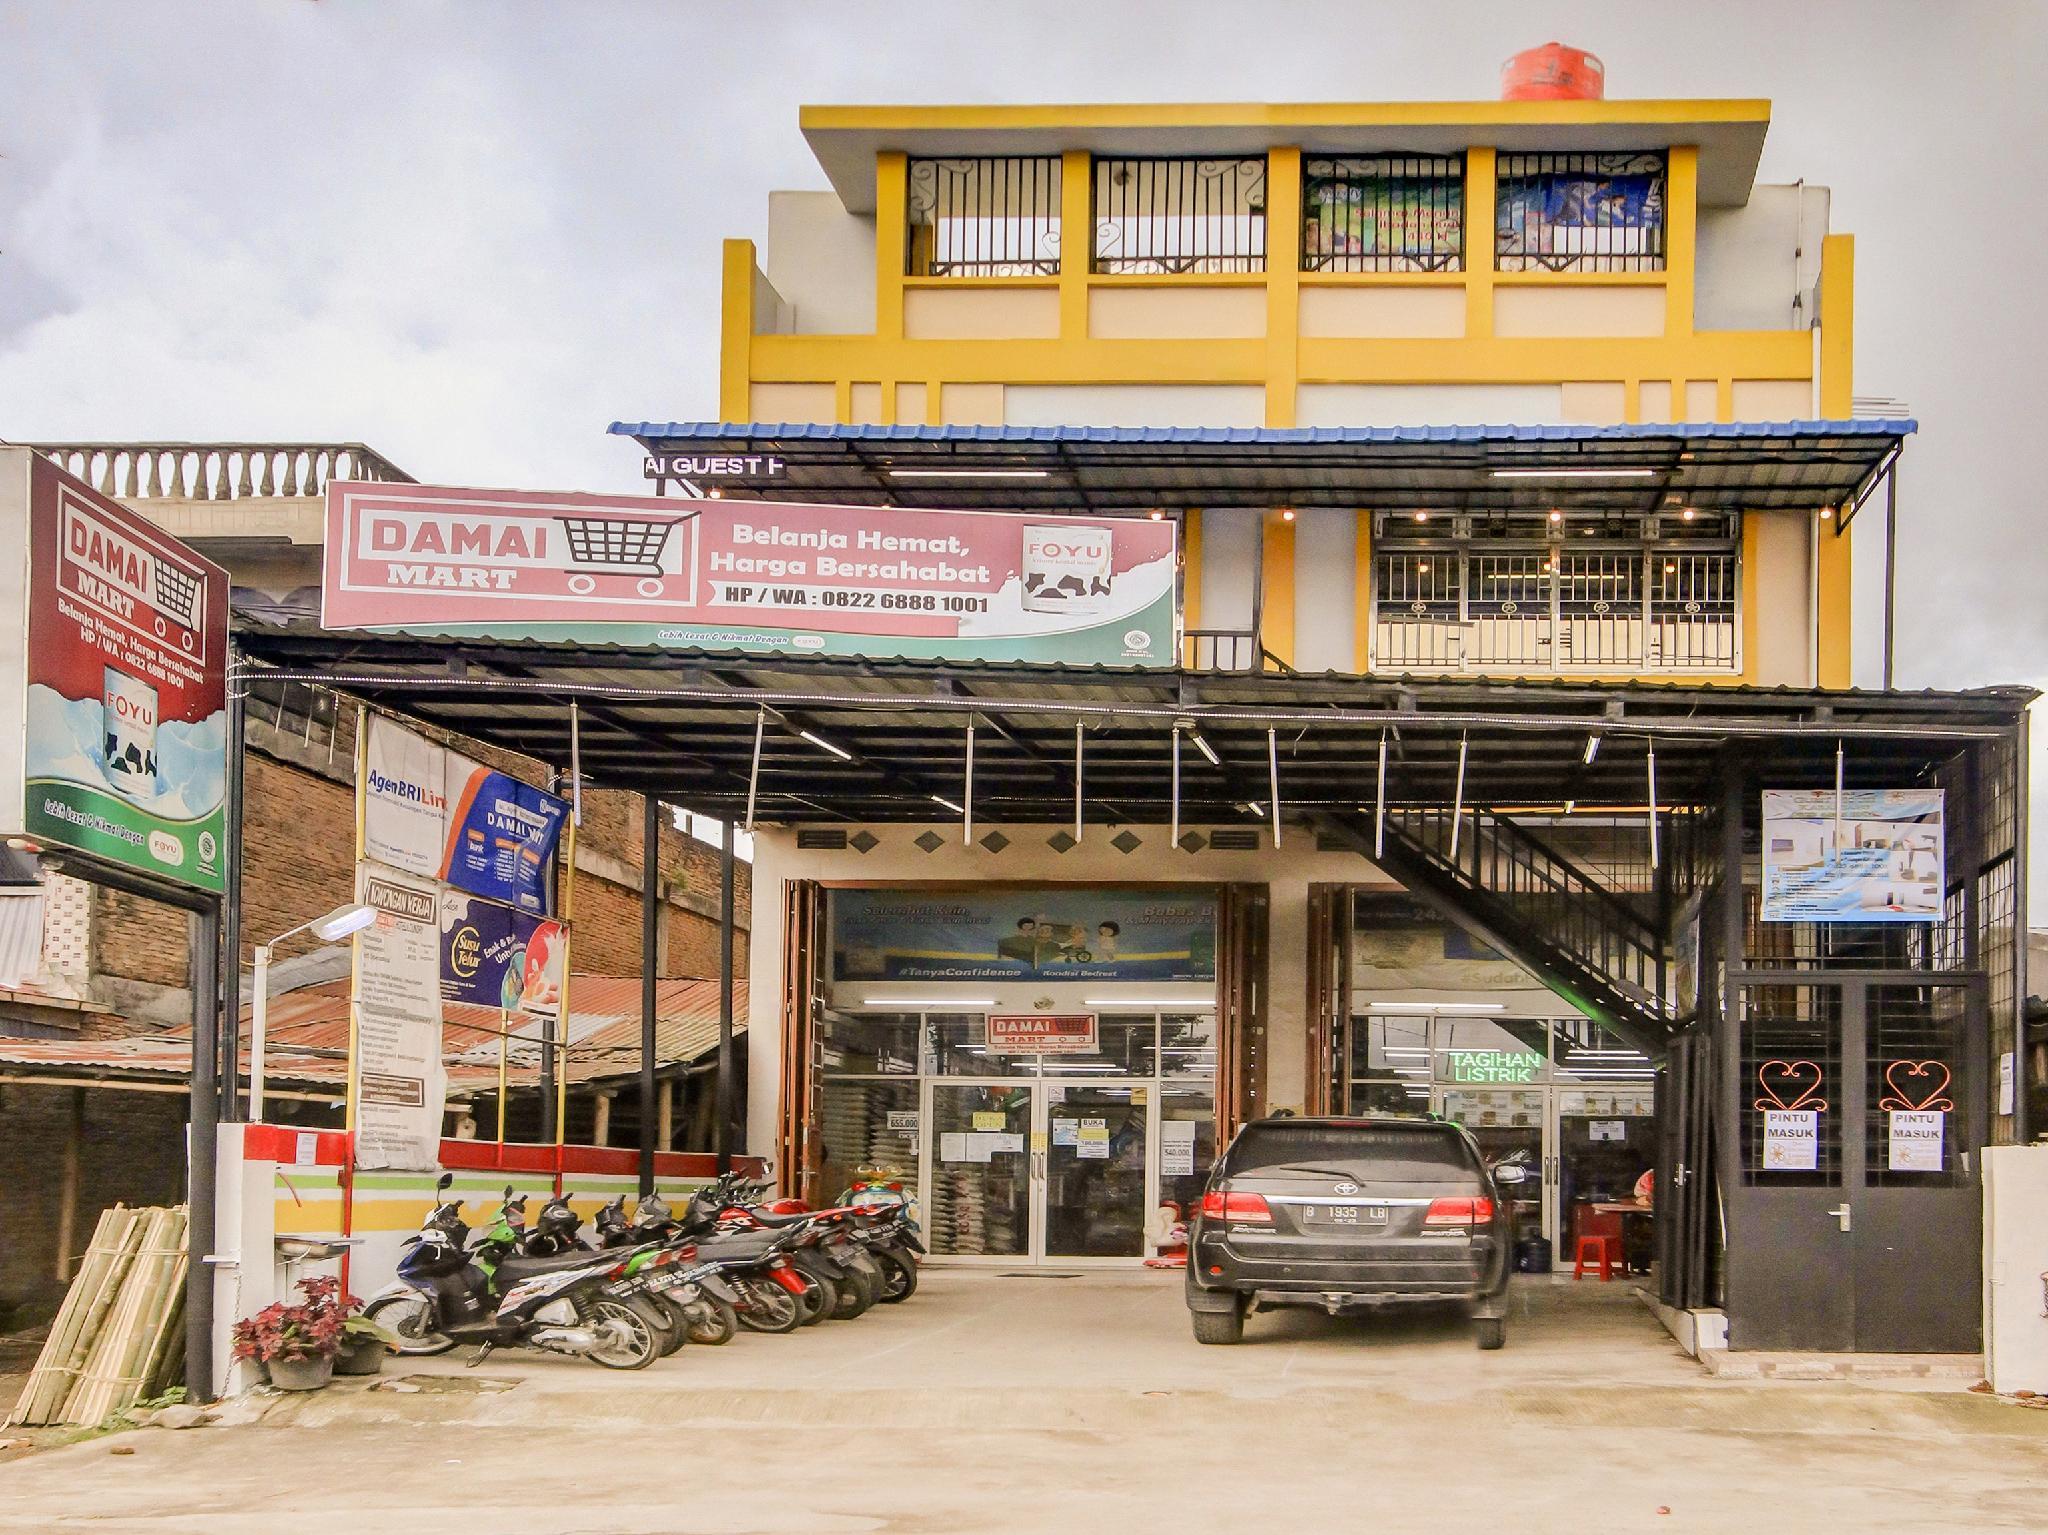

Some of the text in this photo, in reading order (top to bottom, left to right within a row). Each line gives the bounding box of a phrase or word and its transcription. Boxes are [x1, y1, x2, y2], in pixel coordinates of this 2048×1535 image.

[672, 457, 761, 475] GUEST
[371, 519, 547, 559] DAMAI
[733, 524, 970, 557] Belanja Hemat,
[71, 516, 147, 594] DAMAI
[1029, 543, 1101, 558] FOYU
[710, 552, 991, 583] Harga Bersahabat
[387, 563, 517, 590] MART
[78, 570, 134, 619] MART
[725, 587, 753, 603] HP
[773, 589, 807, 605] WA
[822, 591, 876, 609] 0822
[880, 593, 936, 611] 6888
[941, 596, 988, 613] 1001
[58, 597, 204, 684] Belanja Hemat, Harga Bersahabat
[720, 633, 753, 643] Nikmat
[755, 635, 788, 646] Dengan
[80, 626, 96, 645] HP
[103, 638, 119, 658] WA
[125, 652, 145, 671] 0822
[167, 672, 184, 689] 1001
[107, 691, 152, 725] FOYU
[154, 841, 177, 854] FOYU
[458, 935, 480, 952] Susu
[458, 950, 481, 968] Telur
[899, 967, 1022, 978] #TanyaConfidence
[996, 1021, 1050, 1032] DAMAI
[1449, 1052, 1541, 1067] TAGIHAN
[1455, 1067, 1531, 1082] LISTRIK
[1770, 1114, 1808, 1122] PINTU
[1896, 1114, 1934, 1123] PINTU
[1768, 1129, 1814, 1138] MASUK
[1893, 1129, 1940, 1139] MASUK
[1328, 1206, 1358, 1218] 1935
